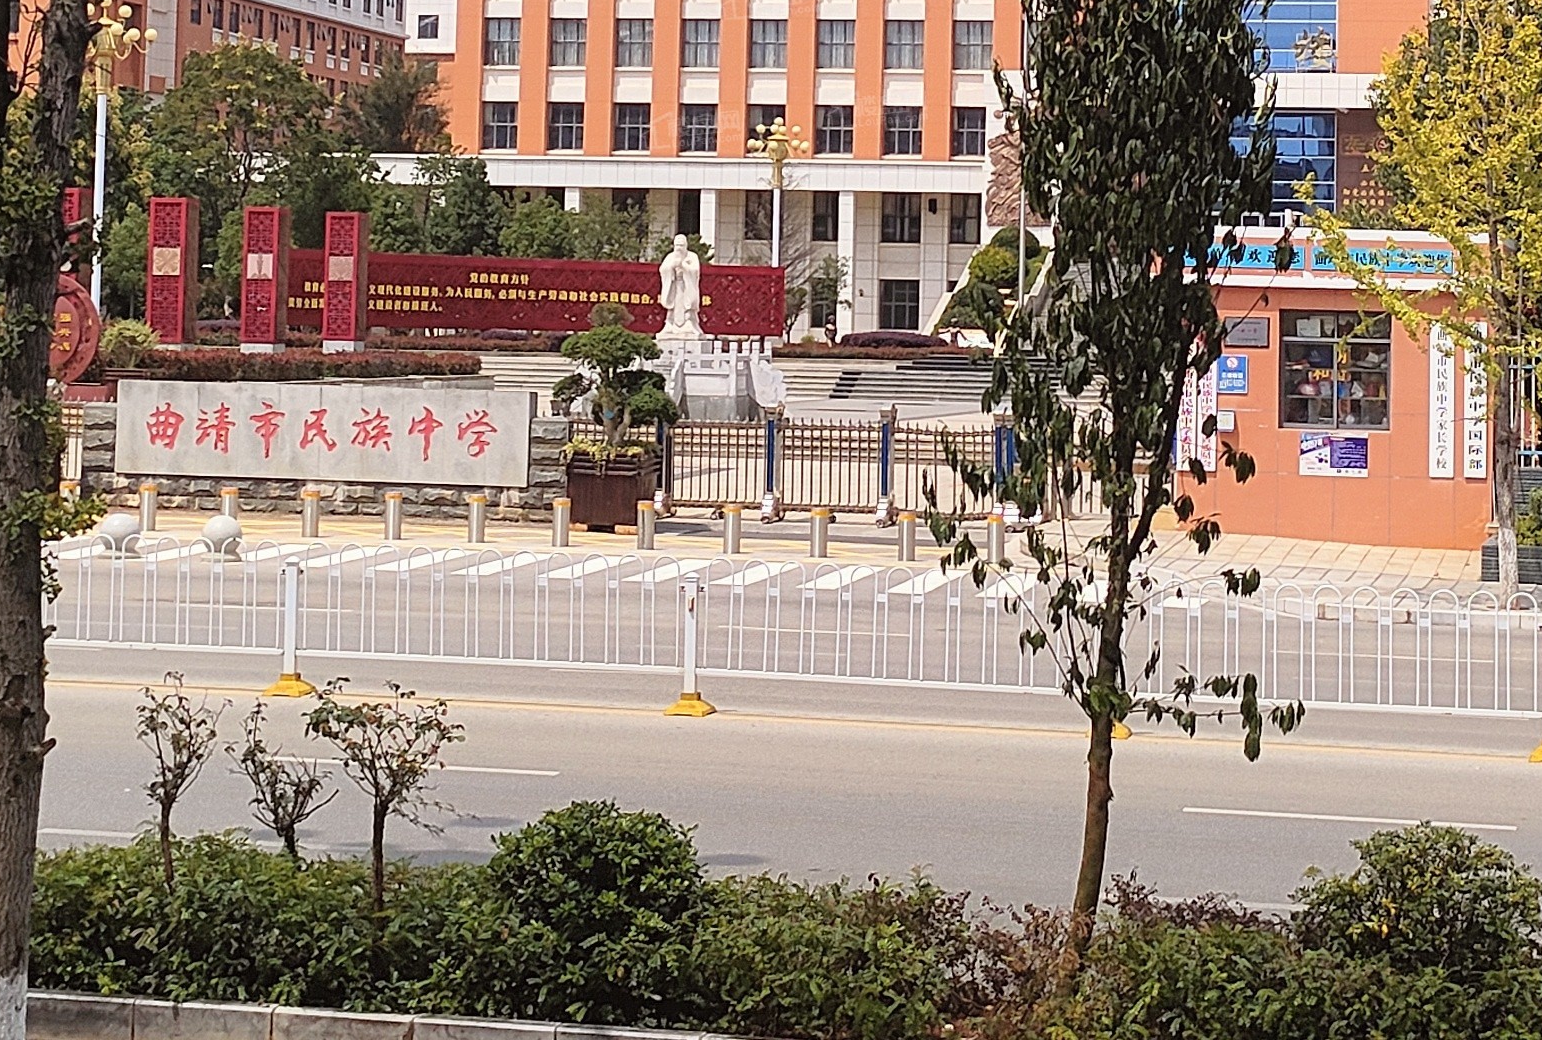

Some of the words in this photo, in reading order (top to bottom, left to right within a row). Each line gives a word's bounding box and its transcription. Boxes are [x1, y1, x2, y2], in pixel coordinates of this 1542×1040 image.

[146, 401, 498, 461] 曲靖市民族中学
[1436, 330, 1448, 469] 曲市民族中学家长学校
[1469, 326, 1483, 470] 市民中学国际部
